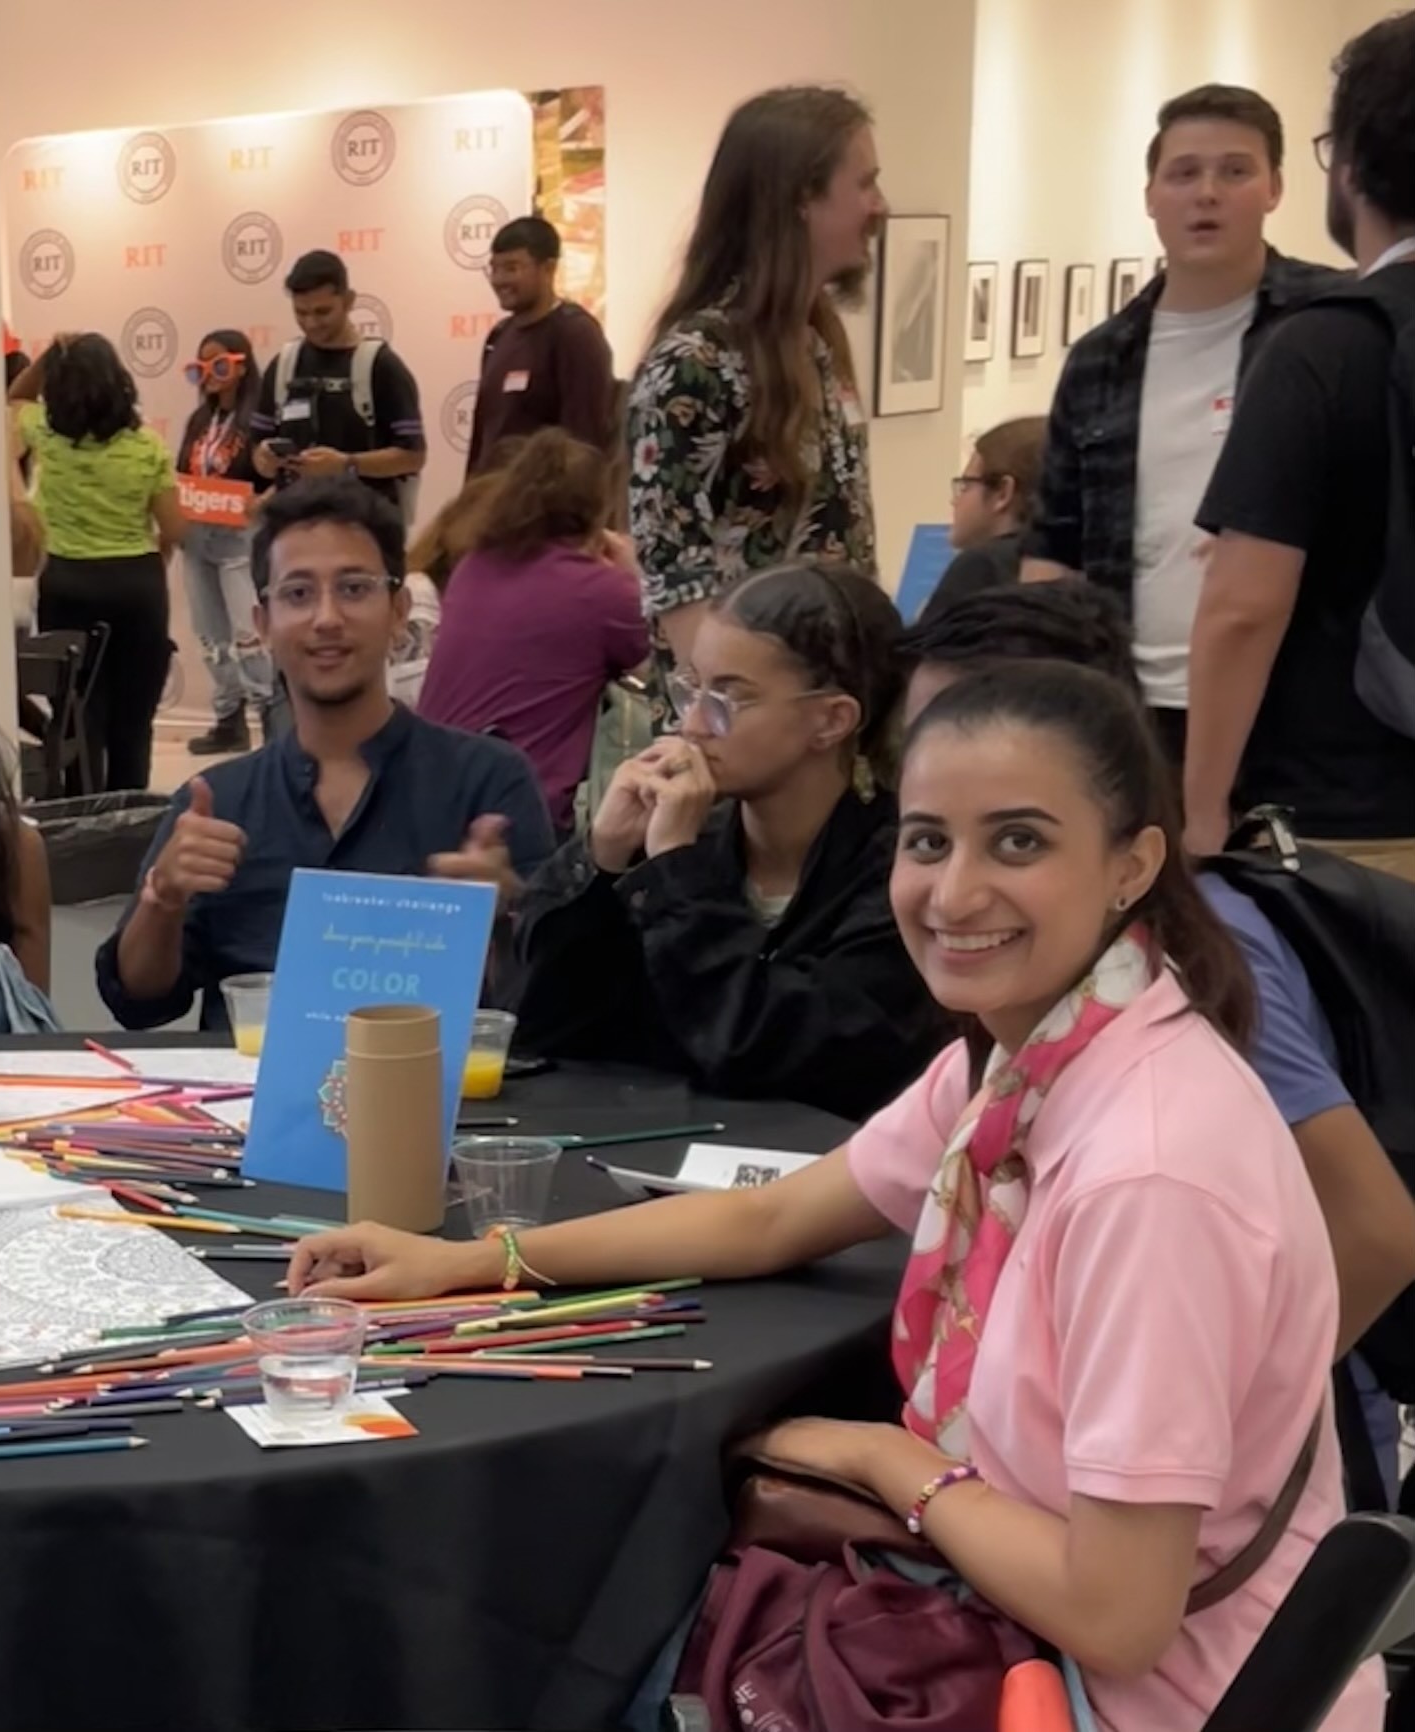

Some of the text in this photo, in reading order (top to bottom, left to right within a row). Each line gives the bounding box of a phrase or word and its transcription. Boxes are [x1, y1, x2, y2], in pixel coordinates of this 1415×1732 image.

[347, 138, 380, 157] RIT
[454, 126, 503, 151] RIT
[131, 158, 162, 177] RIT
[229, 146, 273, 172] RIT
[22, 167, 63, 191] RIT
[338, 228, 384, 252] RIT
[460, 222, 495, 241] RIT
[125, 244, 166, 268] RIT
[237, 238, 268, 256] RIT
[33, 254, 61, 273] RIT
[135, 333, 164, 351] RIT
[332, 966, 421, 997] COLOR
